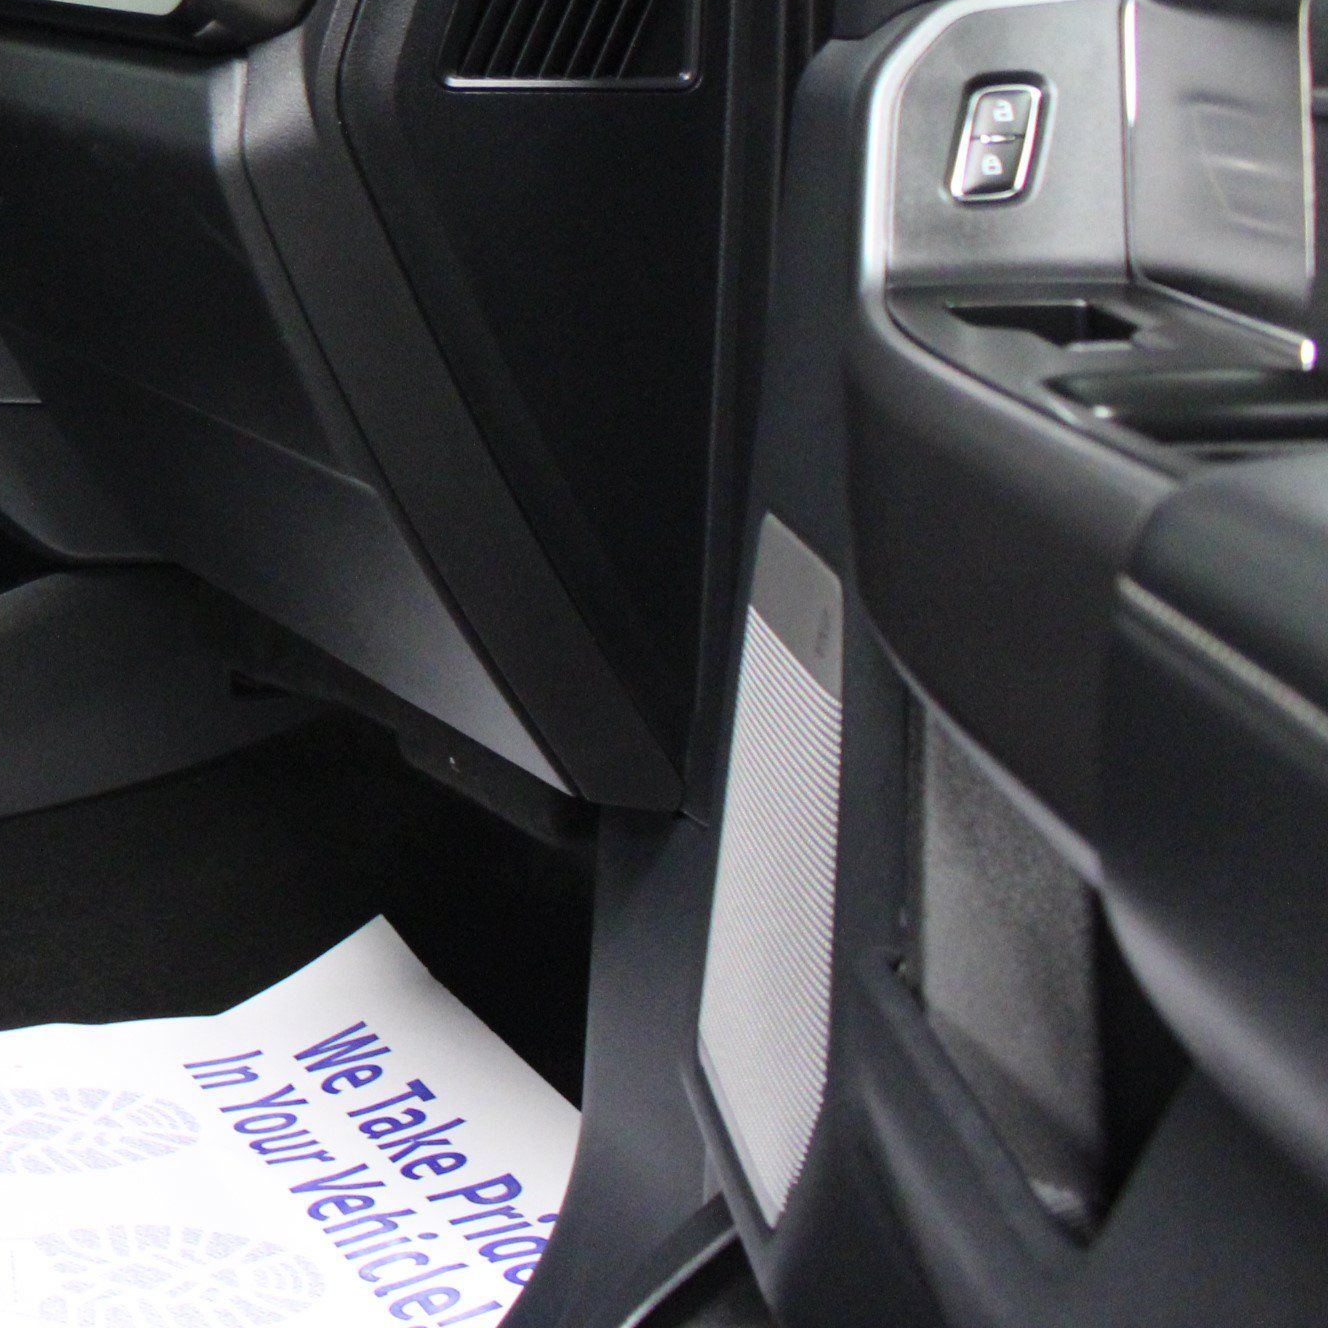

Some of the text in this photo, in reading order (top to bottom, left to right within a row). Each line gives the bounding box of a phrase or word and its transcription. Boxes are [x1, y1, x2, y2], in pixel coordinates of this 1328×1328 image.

[183, 1049, 504, 1328] In Your Vehicle!
[293, 1020, 392, 1095] We
[346, 1078, 467, 1180] Take
